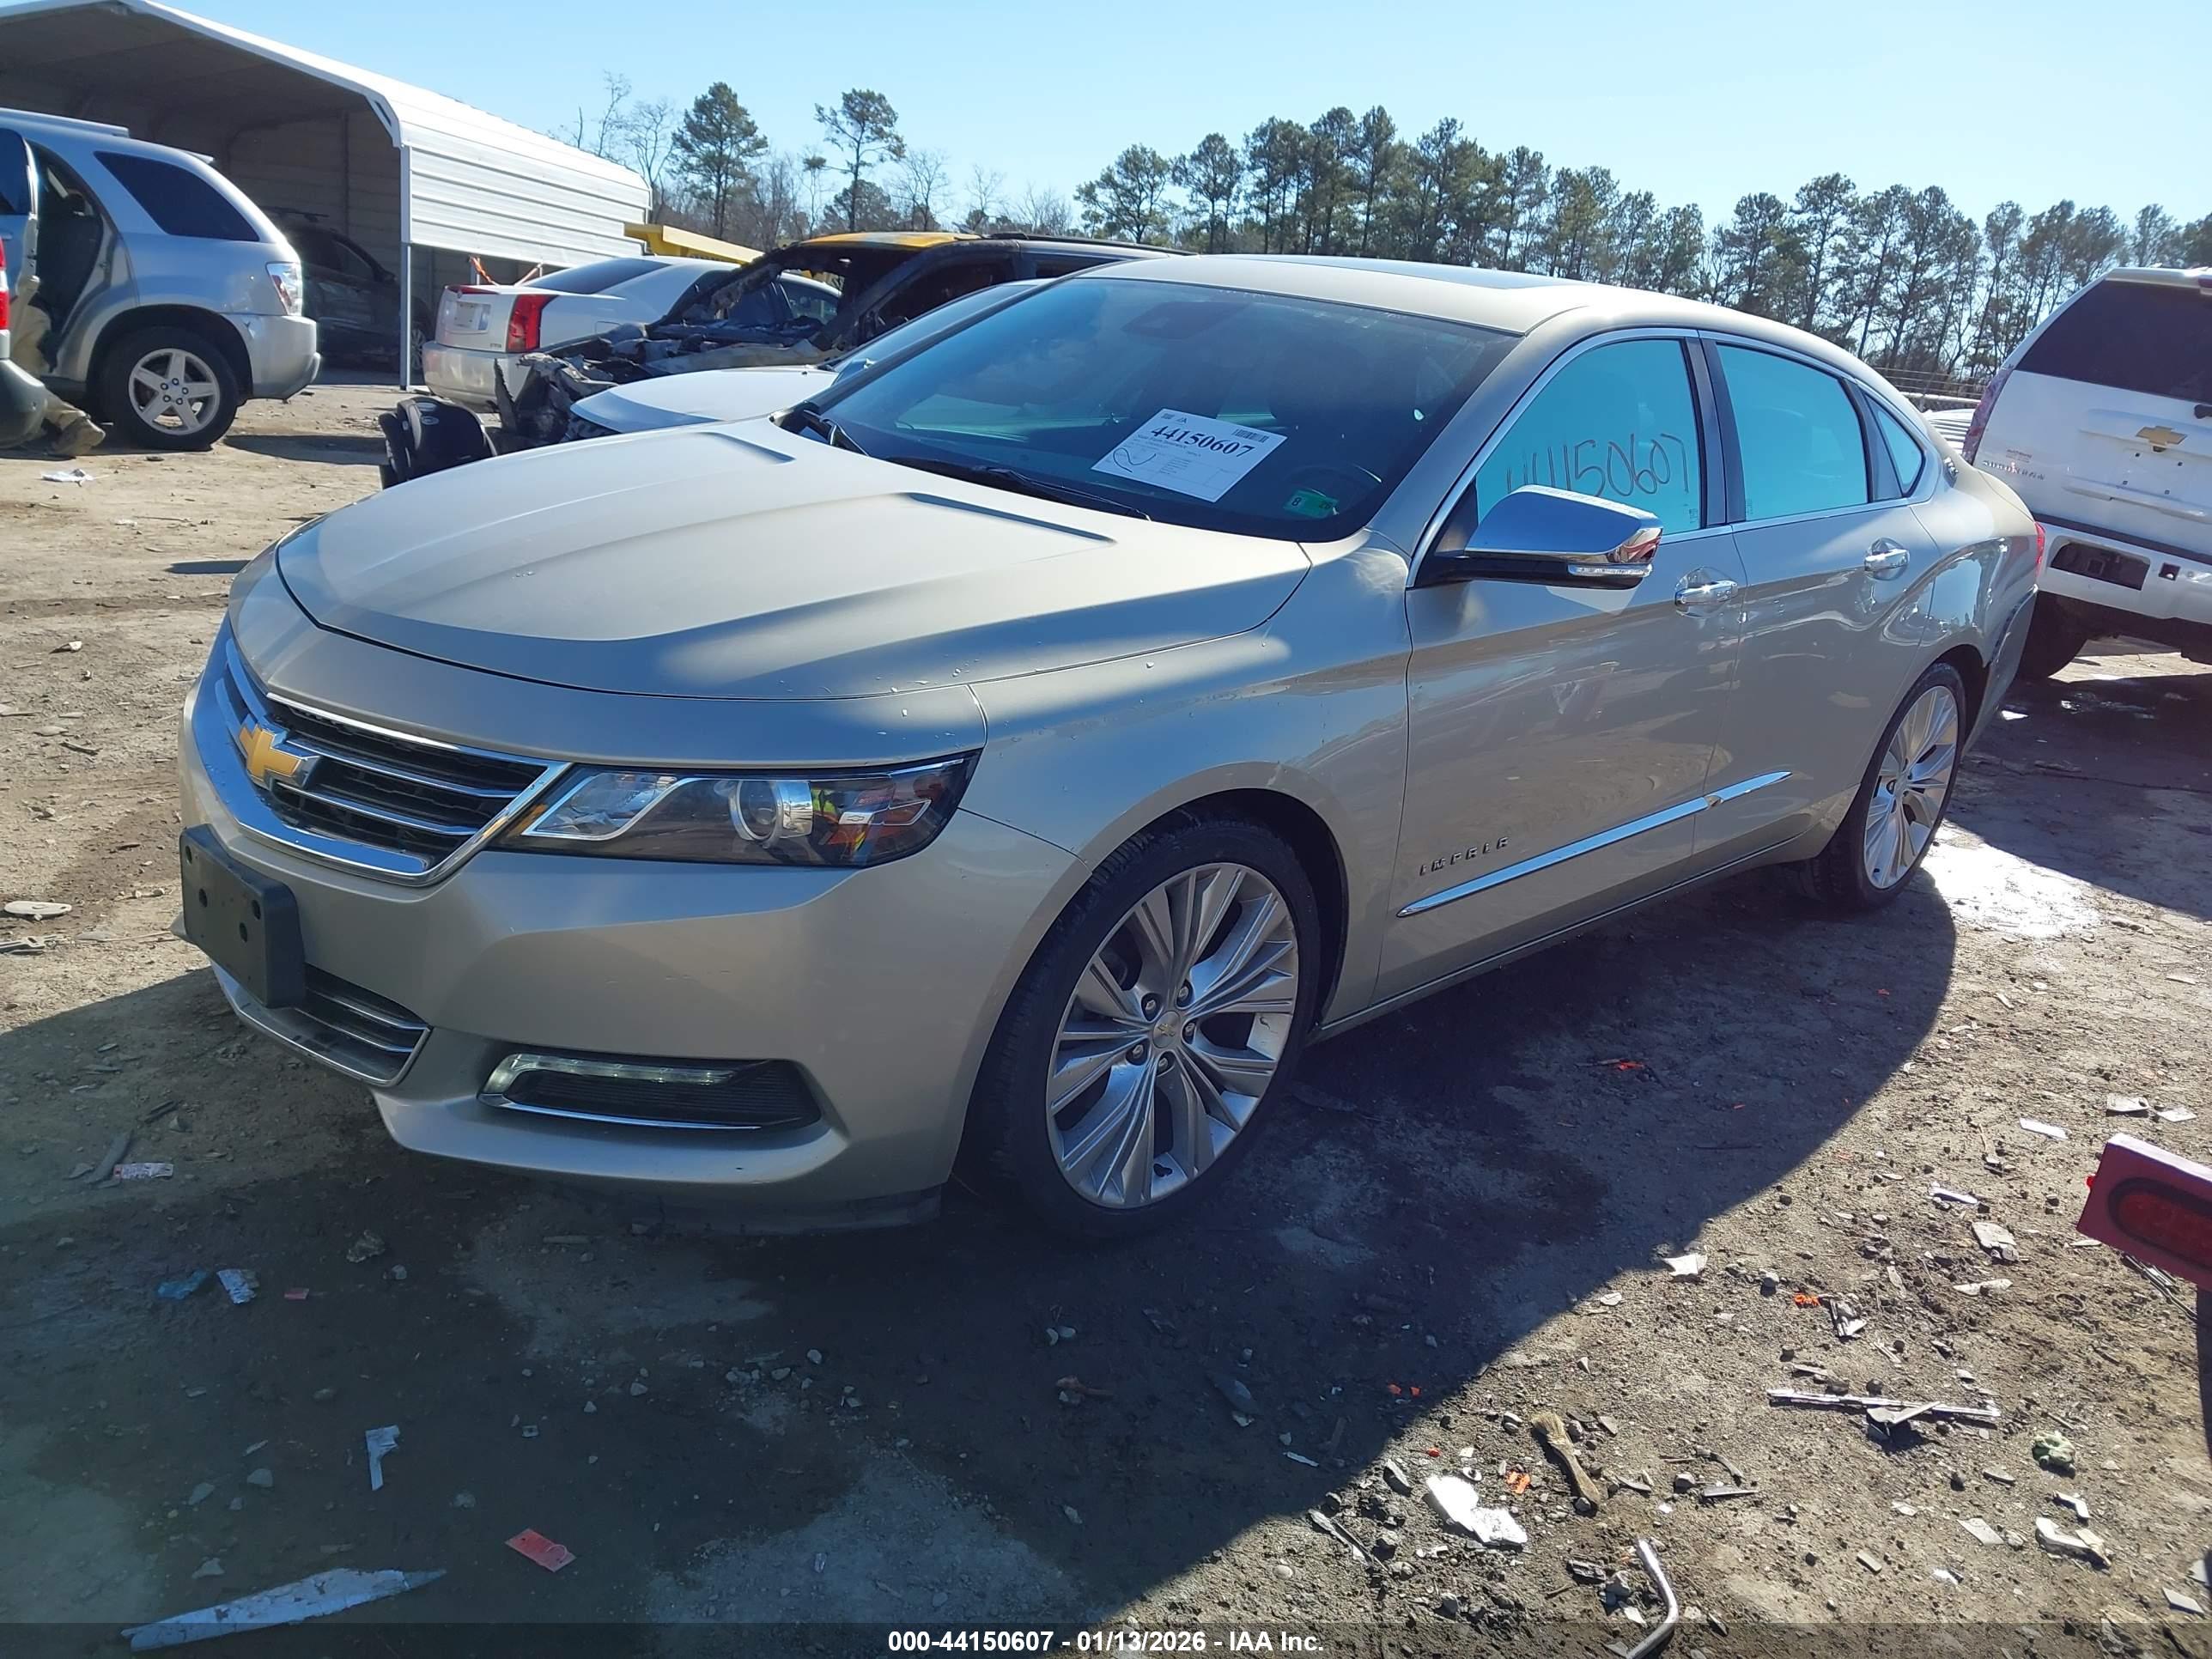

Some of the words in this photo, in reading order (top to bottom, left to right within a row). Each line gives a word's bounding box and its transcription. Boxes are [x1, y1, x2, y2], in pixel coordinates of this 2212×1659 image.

[1151, 425, 1255, 458] 44150607
[1291, 496, 1303, 507] 8
[1419, 836, 1509, 876] IMPALA
